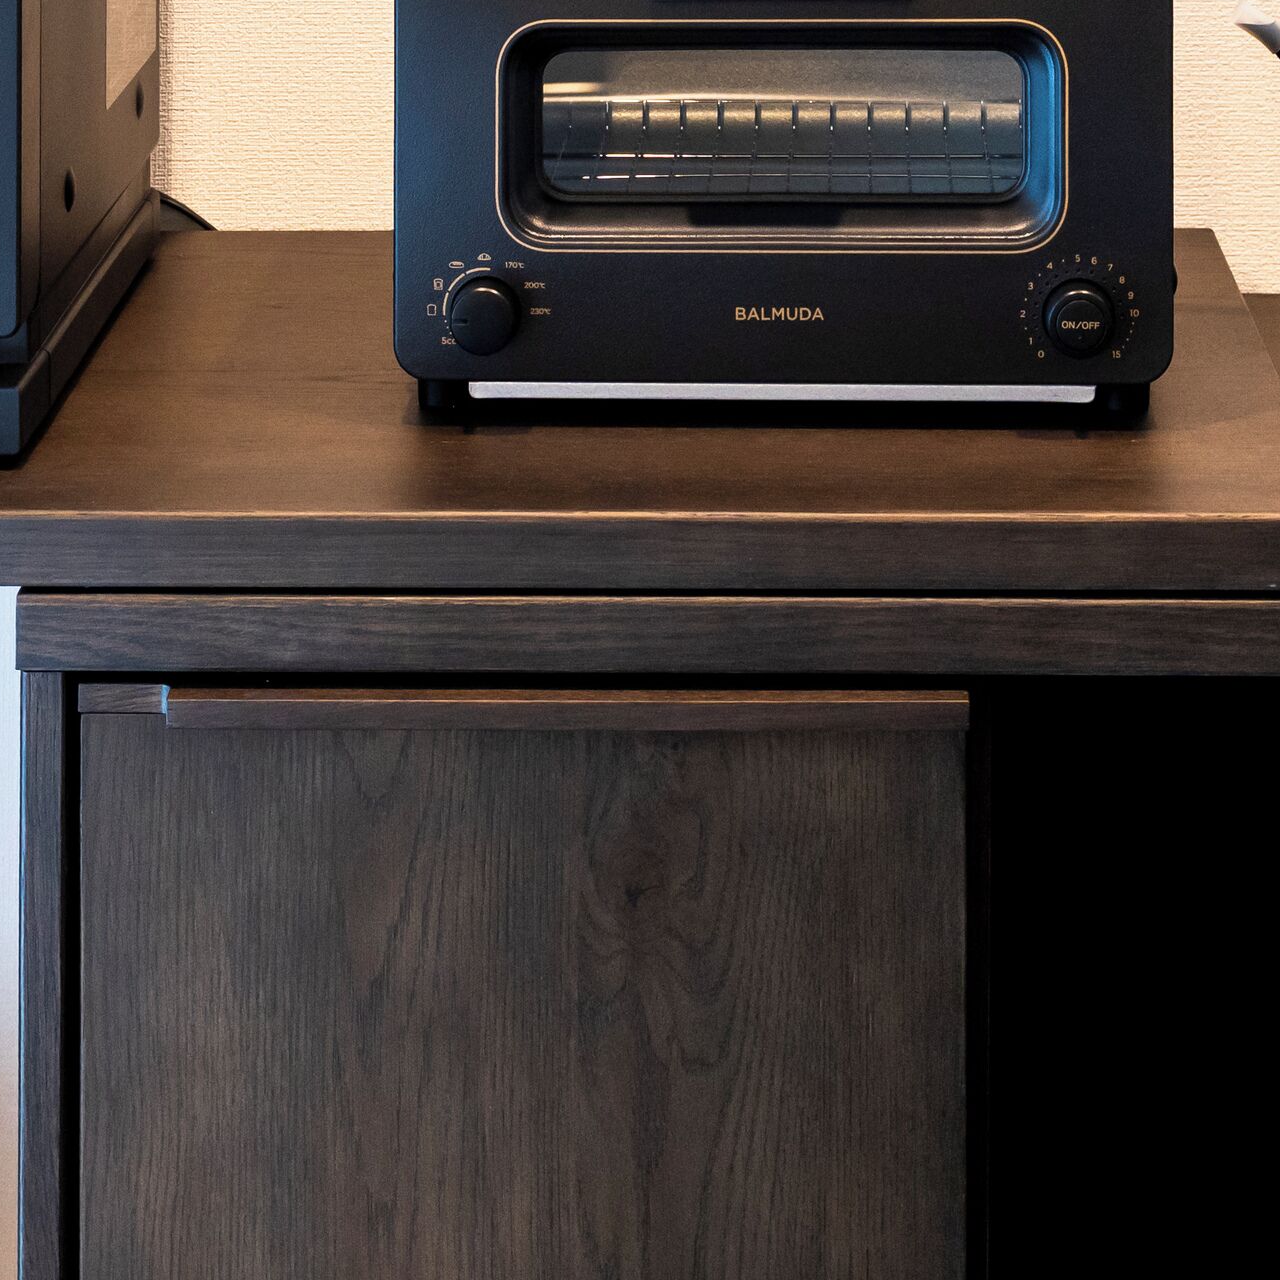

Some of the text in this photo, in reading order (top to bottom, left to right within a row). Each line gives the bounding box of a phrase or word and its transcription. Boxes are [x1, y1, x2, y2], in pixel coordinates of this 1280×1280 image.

[1075, 254, 1081, 263] 5
[1090, 257, 1098, 265] 6
[1046, 262, 1053, 270] 4
[1107, 263, 1114, 272] 7
[1119, 275, 1126, 285] 8
[1027, 281, 1034, 290] 3
[1127, 291, 1135, 300] 9
[735, 306, 825, 321] BALMUDA
[1020, 310, 1026, 318] 2
[1129, 308, 1140, 317] 10
[1061, 320, 1101, 330] ON/OFF
[1037, 349, 1045, 359] 0
[1112, 350, 1121, 359] 15
